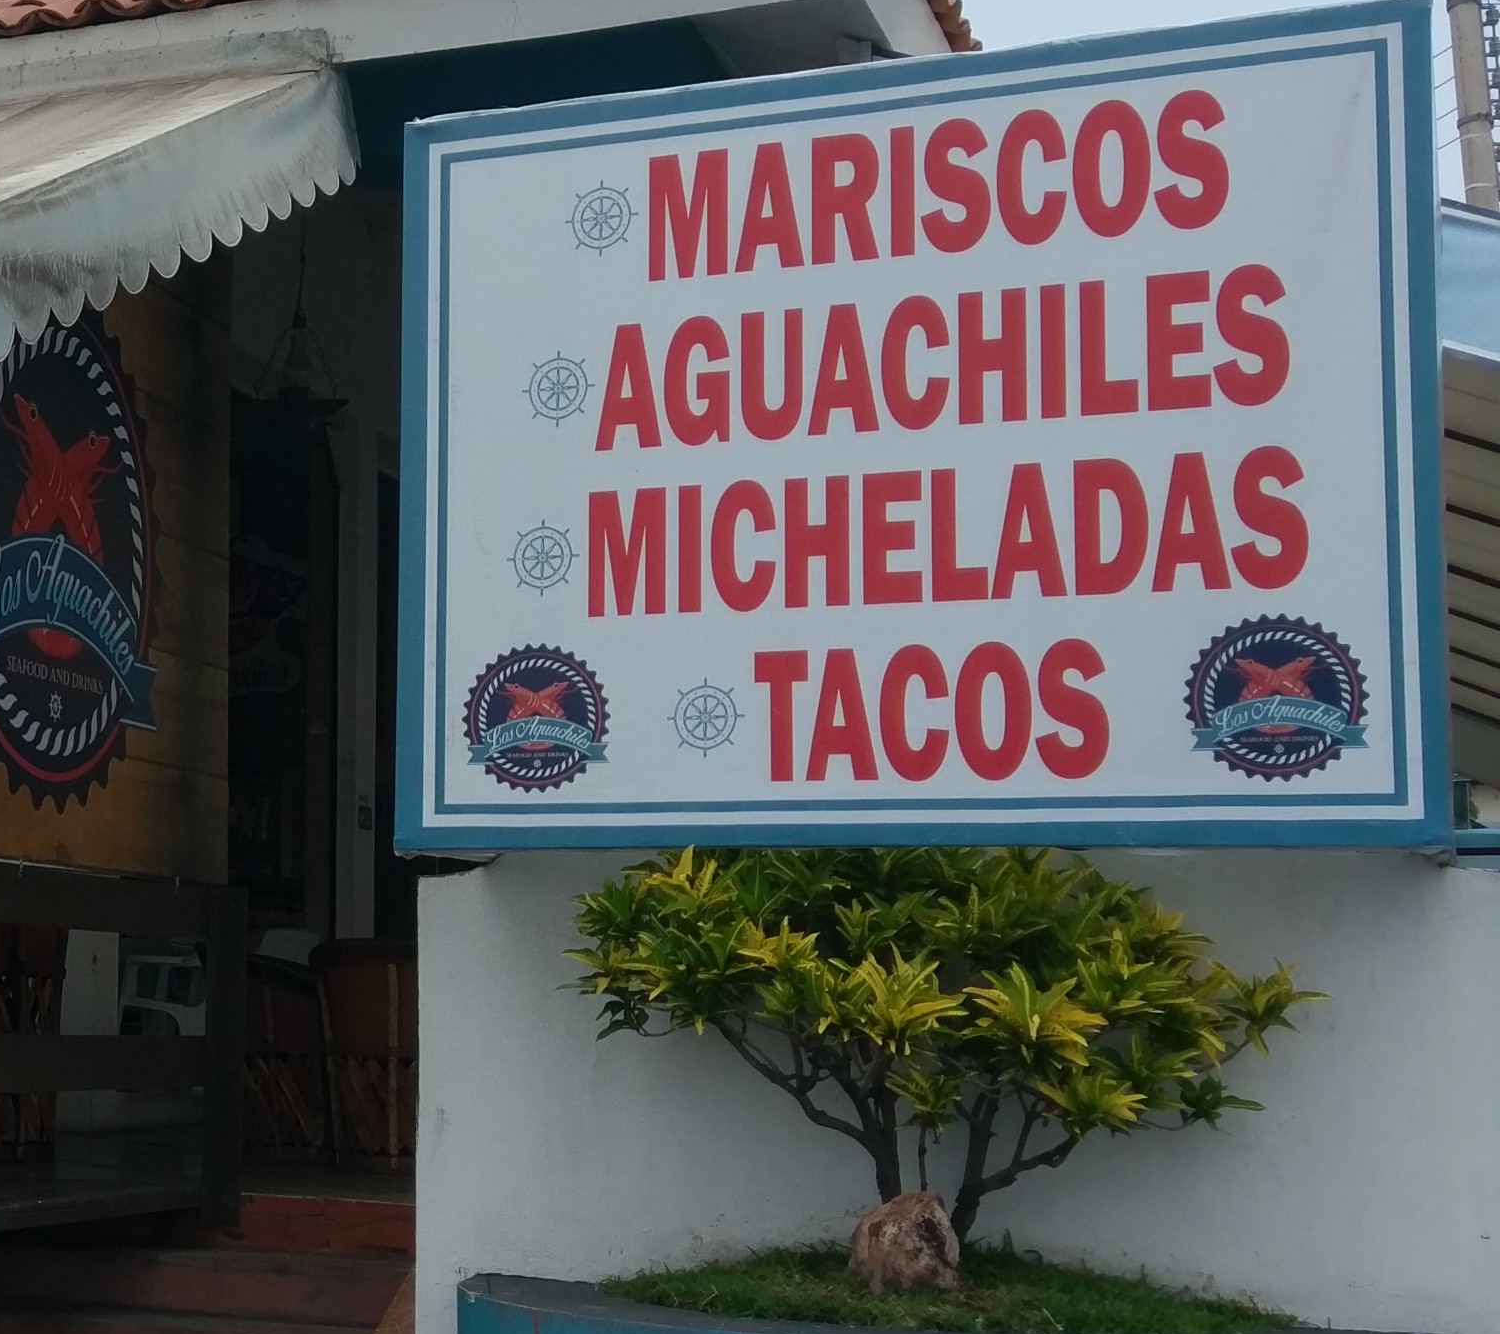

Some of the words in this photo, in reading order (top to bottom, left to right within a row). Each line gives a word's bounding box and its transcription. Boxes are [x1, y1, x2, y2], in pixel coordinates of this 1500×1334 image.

[648, 90, 1229, 281] MARISCOS
[595, 264, 1291, 452] AGUACHILES
[587, 446, 1309, 617] MICHELADAS
[6, 655, 48, 681] SEAFOOD
[49, 667, 70, 687] AND
[71, 672, 104, 695] DRINKS
[25, 534, 135, 676] Aguachiles
[486, 723, 514, 752] Los
[515, 715, 591, 749] Aguachiles
[754, 639, 1109, 782] TACOS
[1214, 706, 1250, 737] Los
[1251, 694, 1346, 733] Aguachiles
